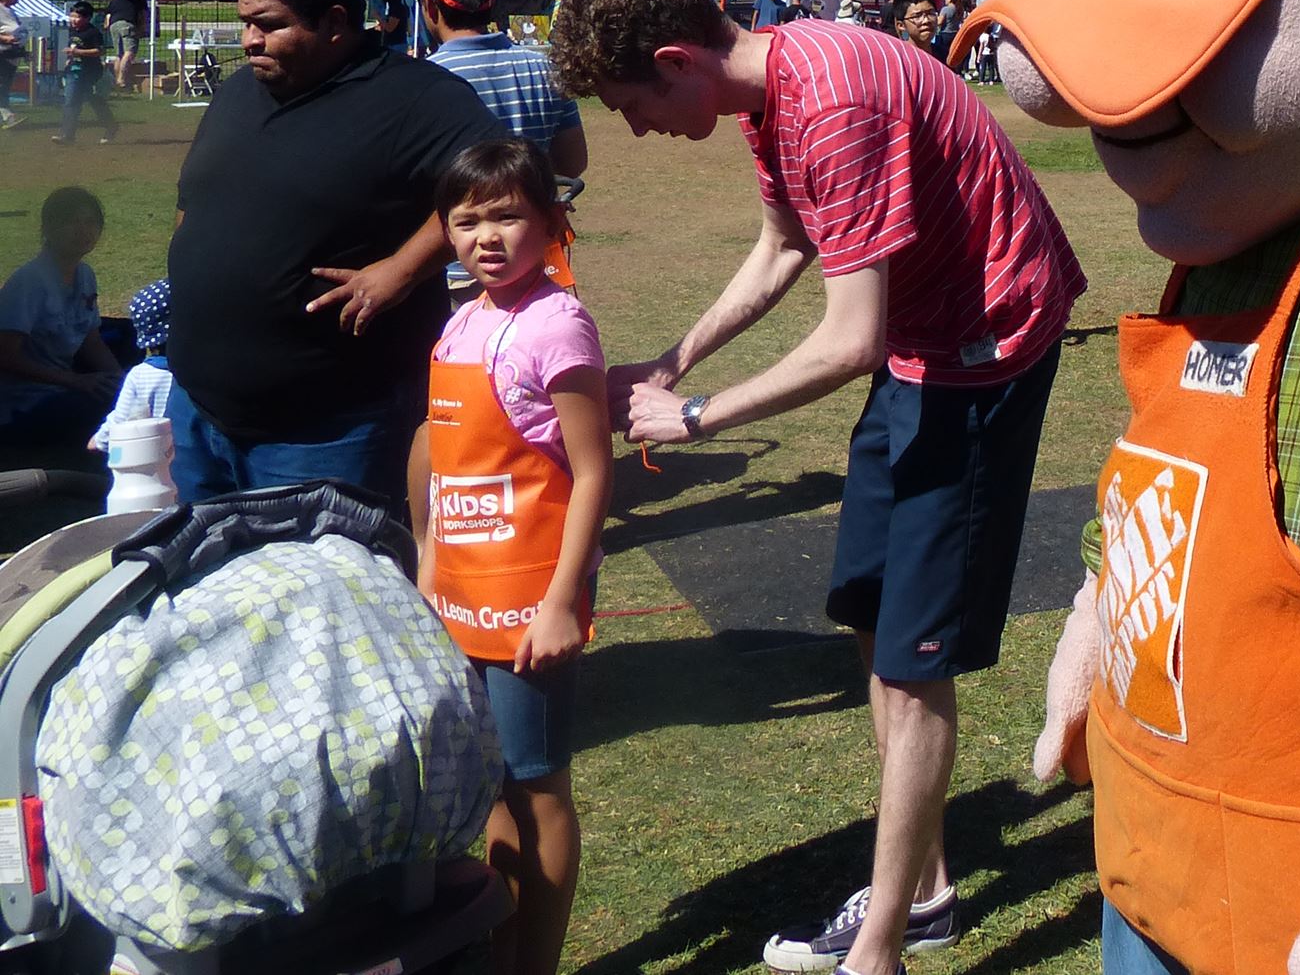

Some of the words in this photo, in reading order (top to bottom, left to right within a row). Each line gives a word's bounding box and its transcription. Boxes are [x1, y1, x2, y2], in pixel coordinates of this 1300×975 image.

[1184, 350, 1248, 386] HOMER
[442, 492, 498, 517] KIDS
[443, 517, 504, 530] WORKSHOPS
[442, 595, 478, 628] Learn.
[479, 601, 543, 629] Crea
